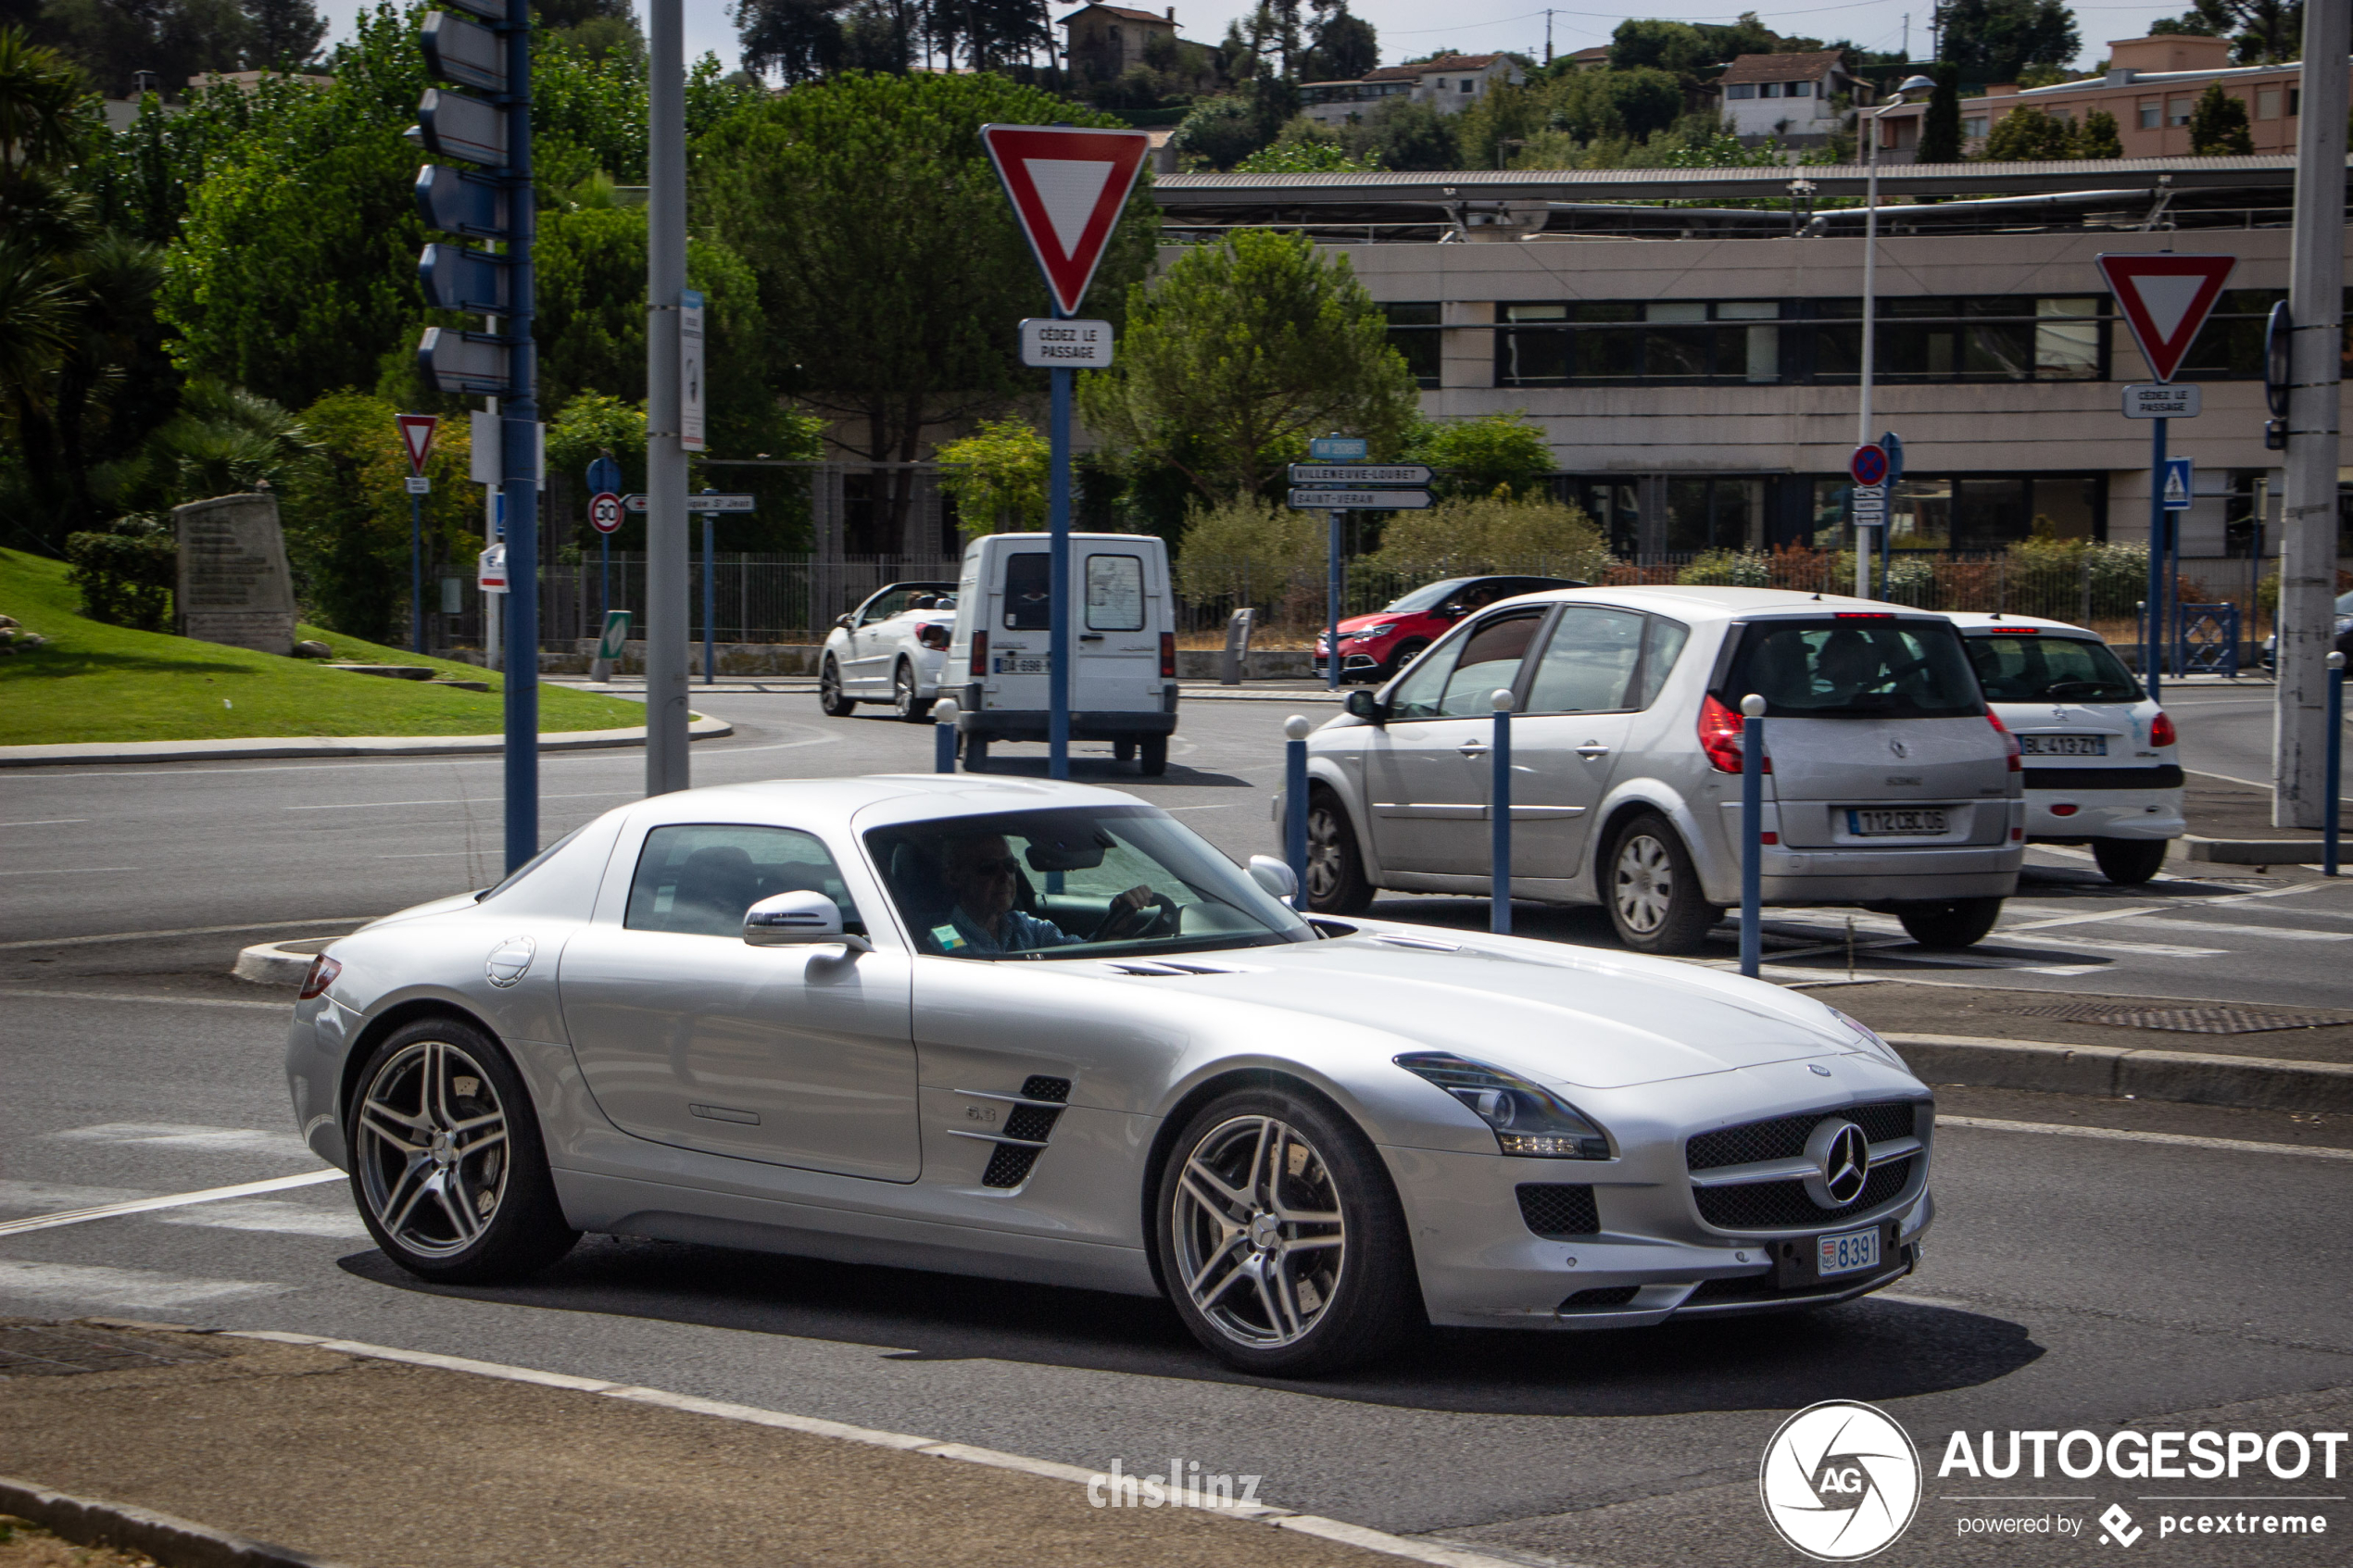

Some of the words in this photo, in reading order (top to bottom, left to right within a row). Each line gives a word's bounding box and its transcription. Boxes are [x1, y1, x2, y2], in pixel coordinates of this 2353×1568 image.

[1083, 330, 1098, 342] LE
[1040, 345, 1095, 359] PASSAGE
[2174, 391, 2188, 400] LE
[2139, 402, 2186, 412] PASSAGE
[1298, 469, 1416, 480] VILLENEUVE-LOUBET
[687, 498, 709, 508] ique
[595, 504, 615, 521] 30
[1838, 1233, 1876, 1268] 8391
[1822, 1255, 1834, 1264] MC
